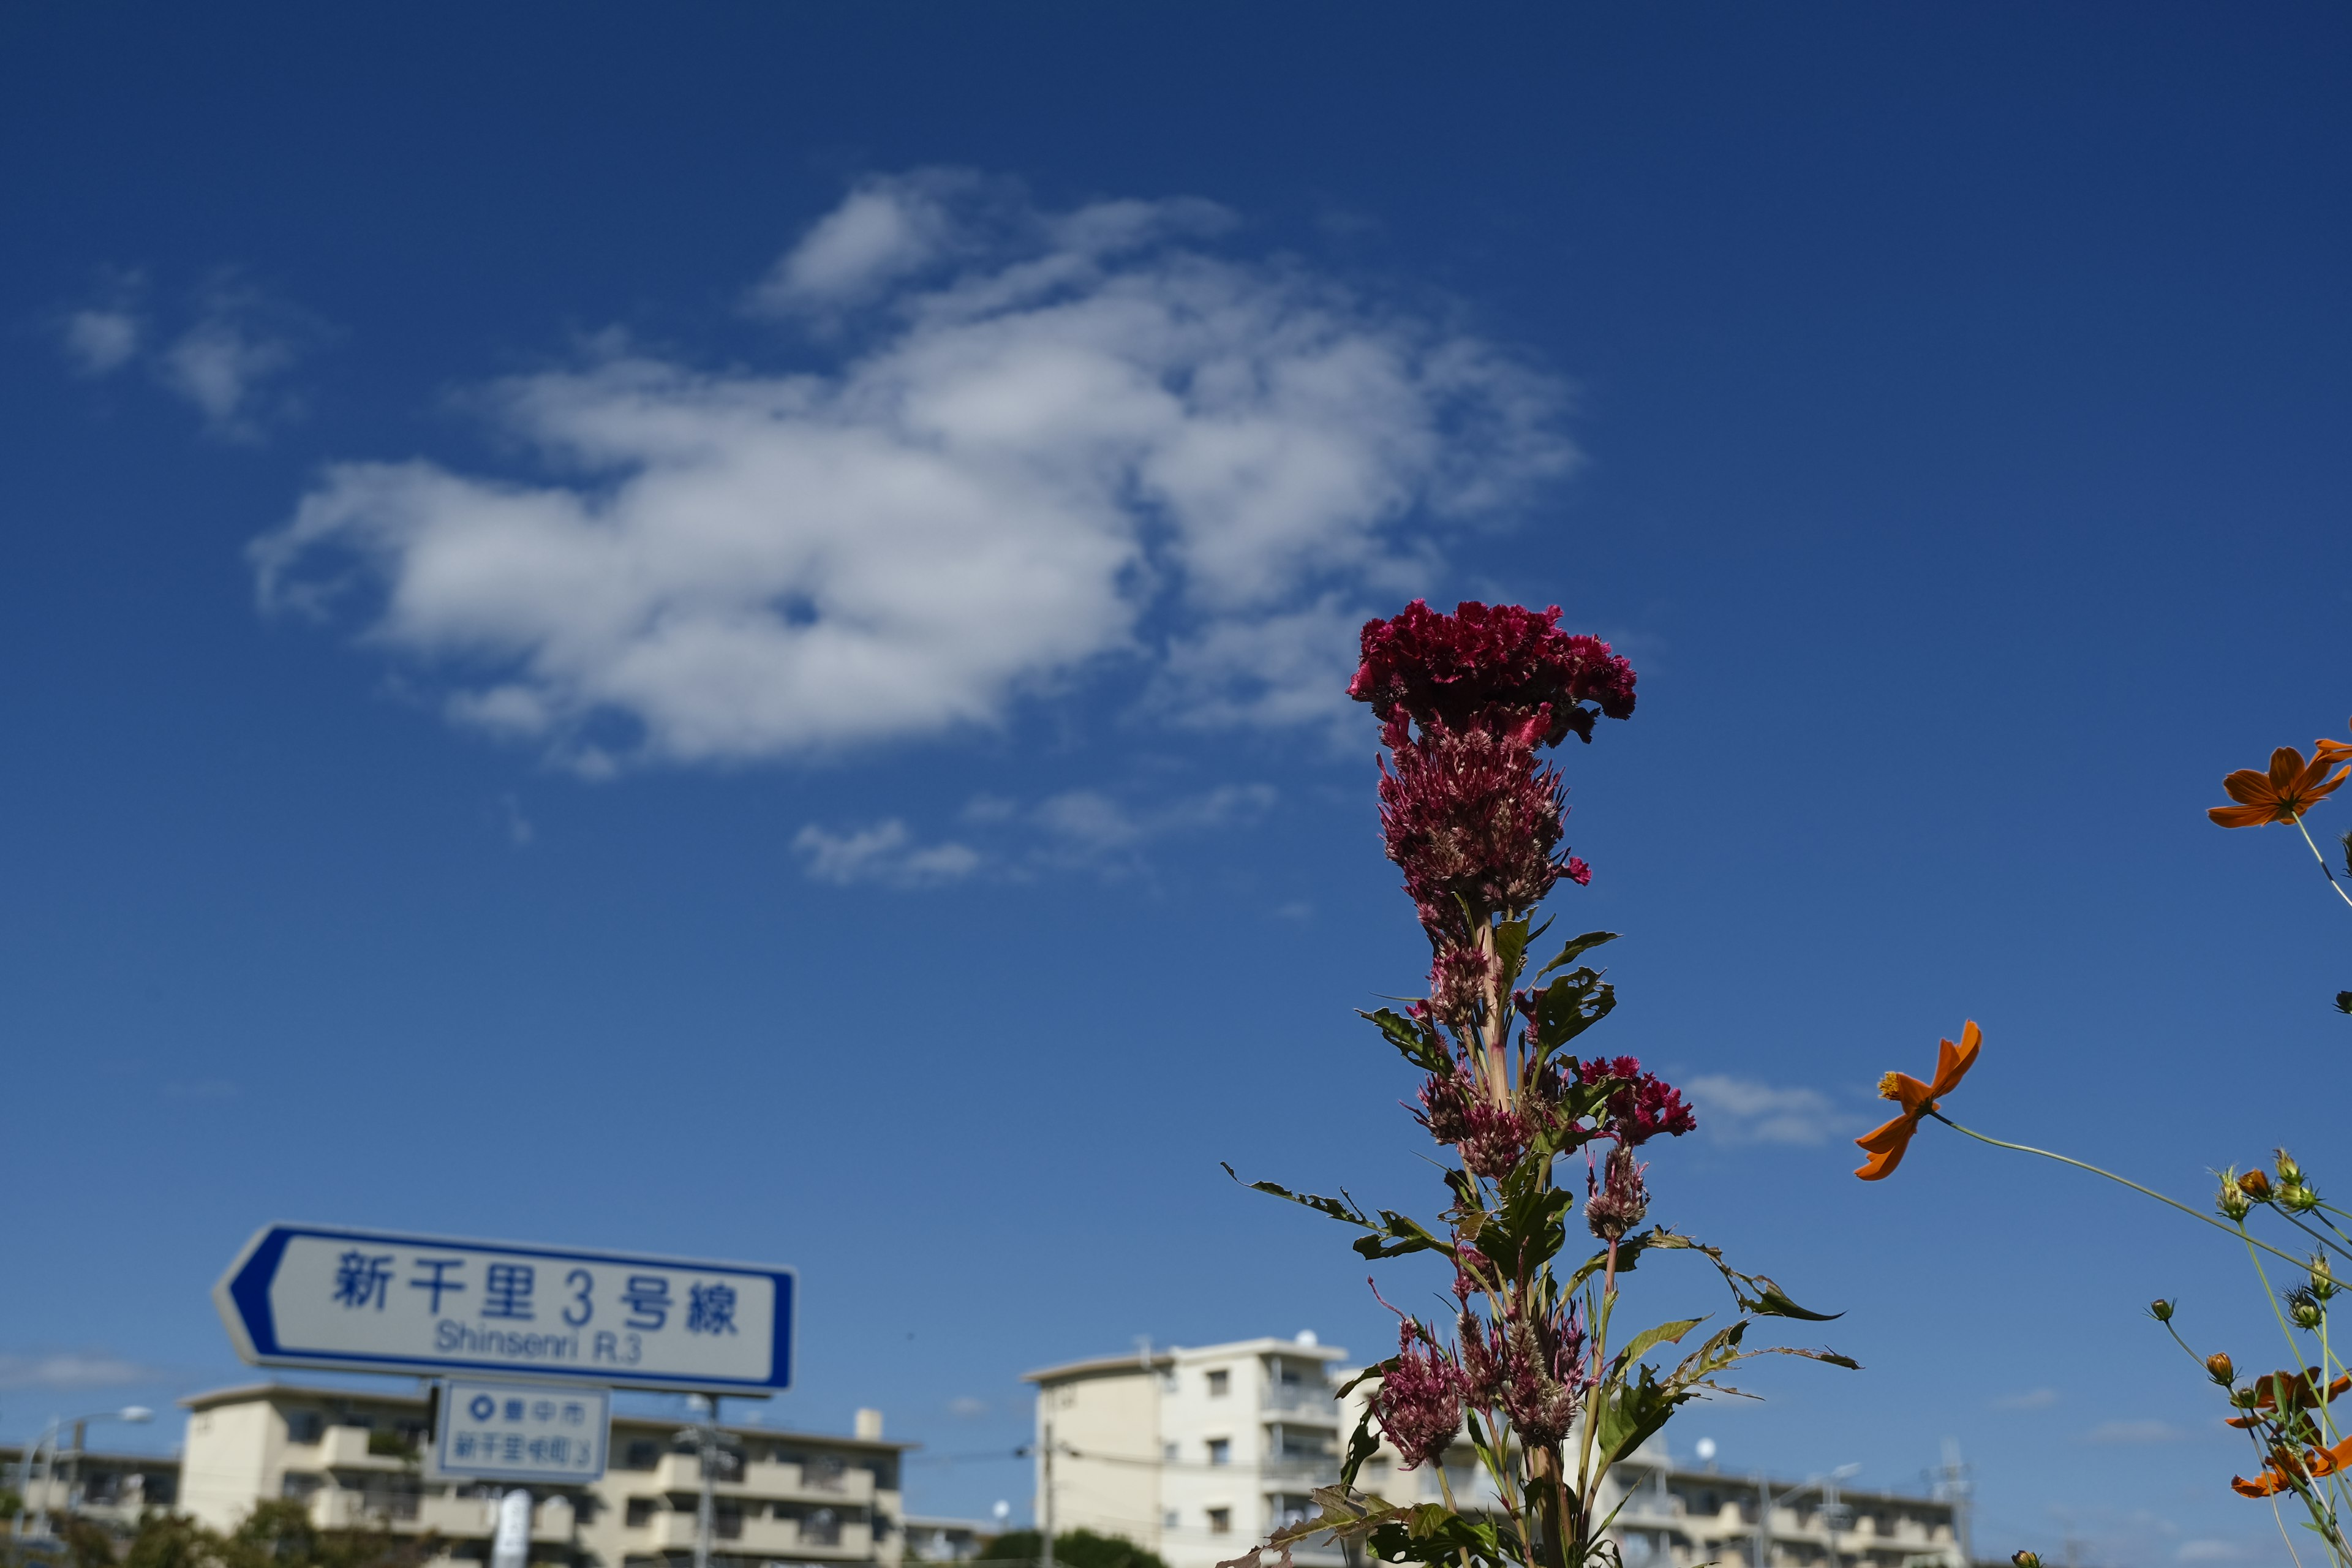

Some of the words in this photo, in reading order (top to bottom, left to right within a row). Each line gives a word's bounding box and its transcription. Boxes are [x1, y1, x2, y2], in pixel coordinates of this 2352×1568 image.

[333, 1250, 737, 1335] 新千里3号線
[435, 1317, 578, 1359] Shinsenri
[592, 1330, 642, 1365] R.3
